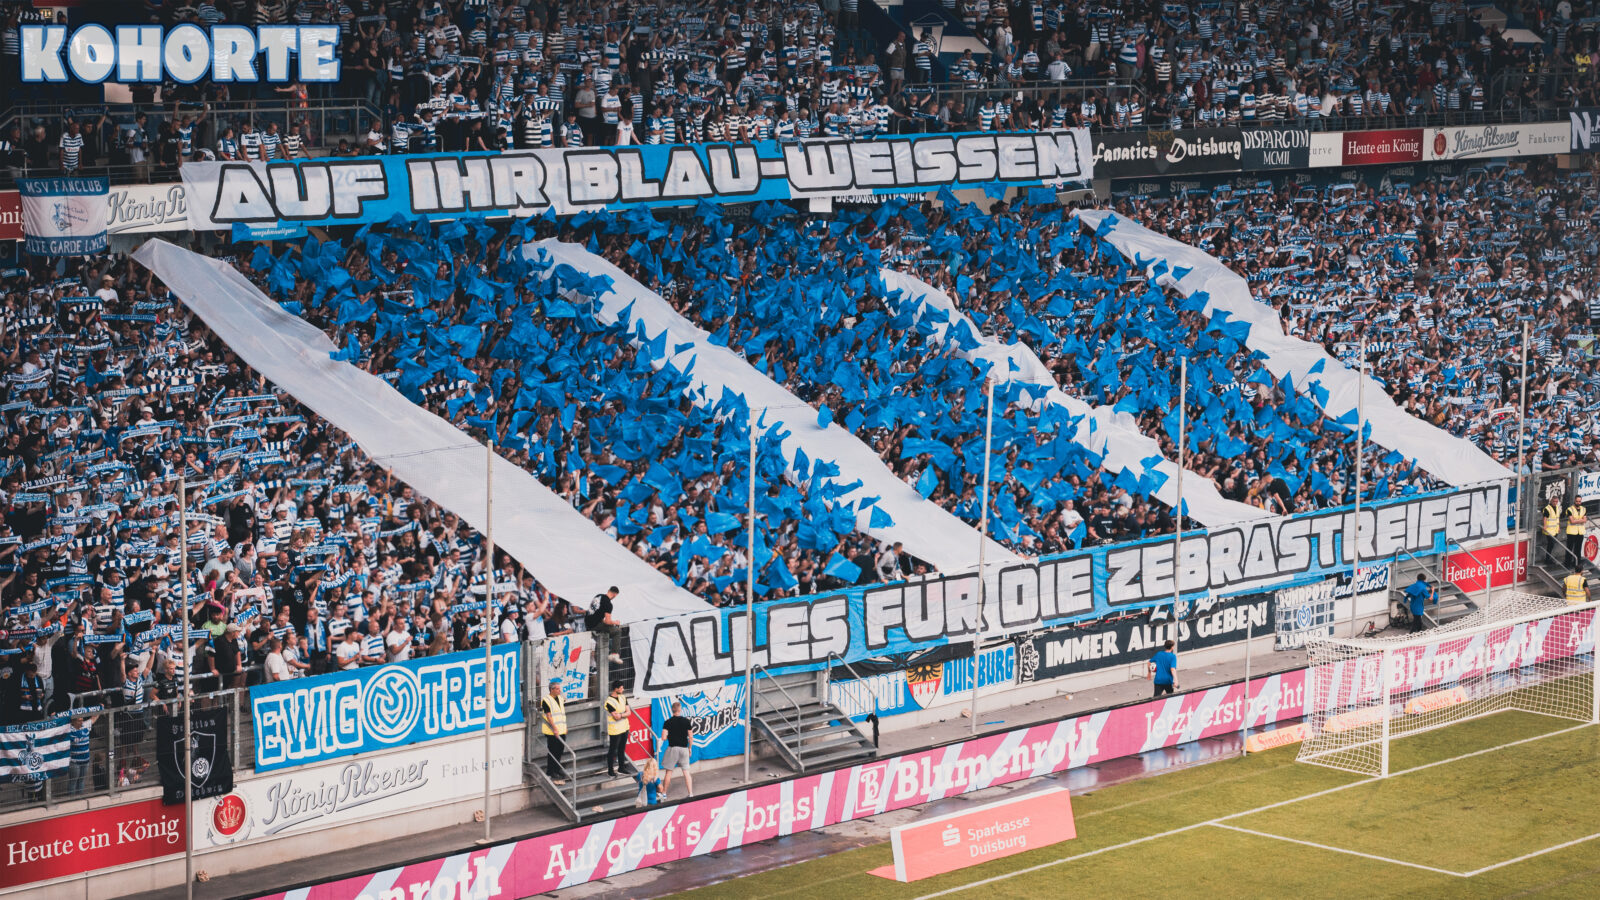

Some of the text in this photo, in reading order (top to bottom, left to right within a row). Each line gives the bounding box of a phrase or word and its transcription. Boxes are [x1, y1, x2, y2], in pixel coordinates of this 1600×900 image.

[1092, 135, 1241, 167] Fanatics Duisburg
[1242, 129, 1310, 149] DISPARGUM
[1310, 146, 1333, 156] urve
[1347, 138, 1420, 157] Heute ein König
[1453, 125, 1520, 154] König Pilsener
[1528, 133, 1566, 145] Fankurve
[1263, 150, 1290, 165] MCMII
[26, 180, 103, 194] MSV FANCLUB
[210, 130, 1082, 223] AUF IHR BLAU-WEISSEN
[107, 191, 167, 225] König
[25, 240, 47, 254] ALTE
[50, 239, 81, 253] GARDE
[1446, 565, 1475, 582] Heute
[1495, 555, 1525, 575] Köng
[642, 594, 850, 691] ALLES
[999, 554, 1095, 629] DIE
[1106, 484, 1502, 606] ZEBRASTREIFEN
[1045, 630, 1120, 668] IMMER
[1196, 601, 1268, 638] GEBEN!
[1390, 620, 1596, 690] Blumenroth Au
[831, 646, 1015, 716] RUHRPOTT DUISBURG
[254, 651, 517, 766] EWIG TREU
[893, 721, 1099, 803] Blumenroth
[1145, 705, 1195, 747] Jetzt
[1200, 694, 1243, 728] erst
[1257, 726, 1295, 749] Sinalco
[261, 759, 430, 826] König Pilsener
[7, 815, 180, 867] Heute ein König
[543, 836, 600, 880] Auf
[710, 785, 818, 841] Zebras!
[967, 815, 1031, 845] Sparkasse
[969, 834, 1027, 858] Duisburg
